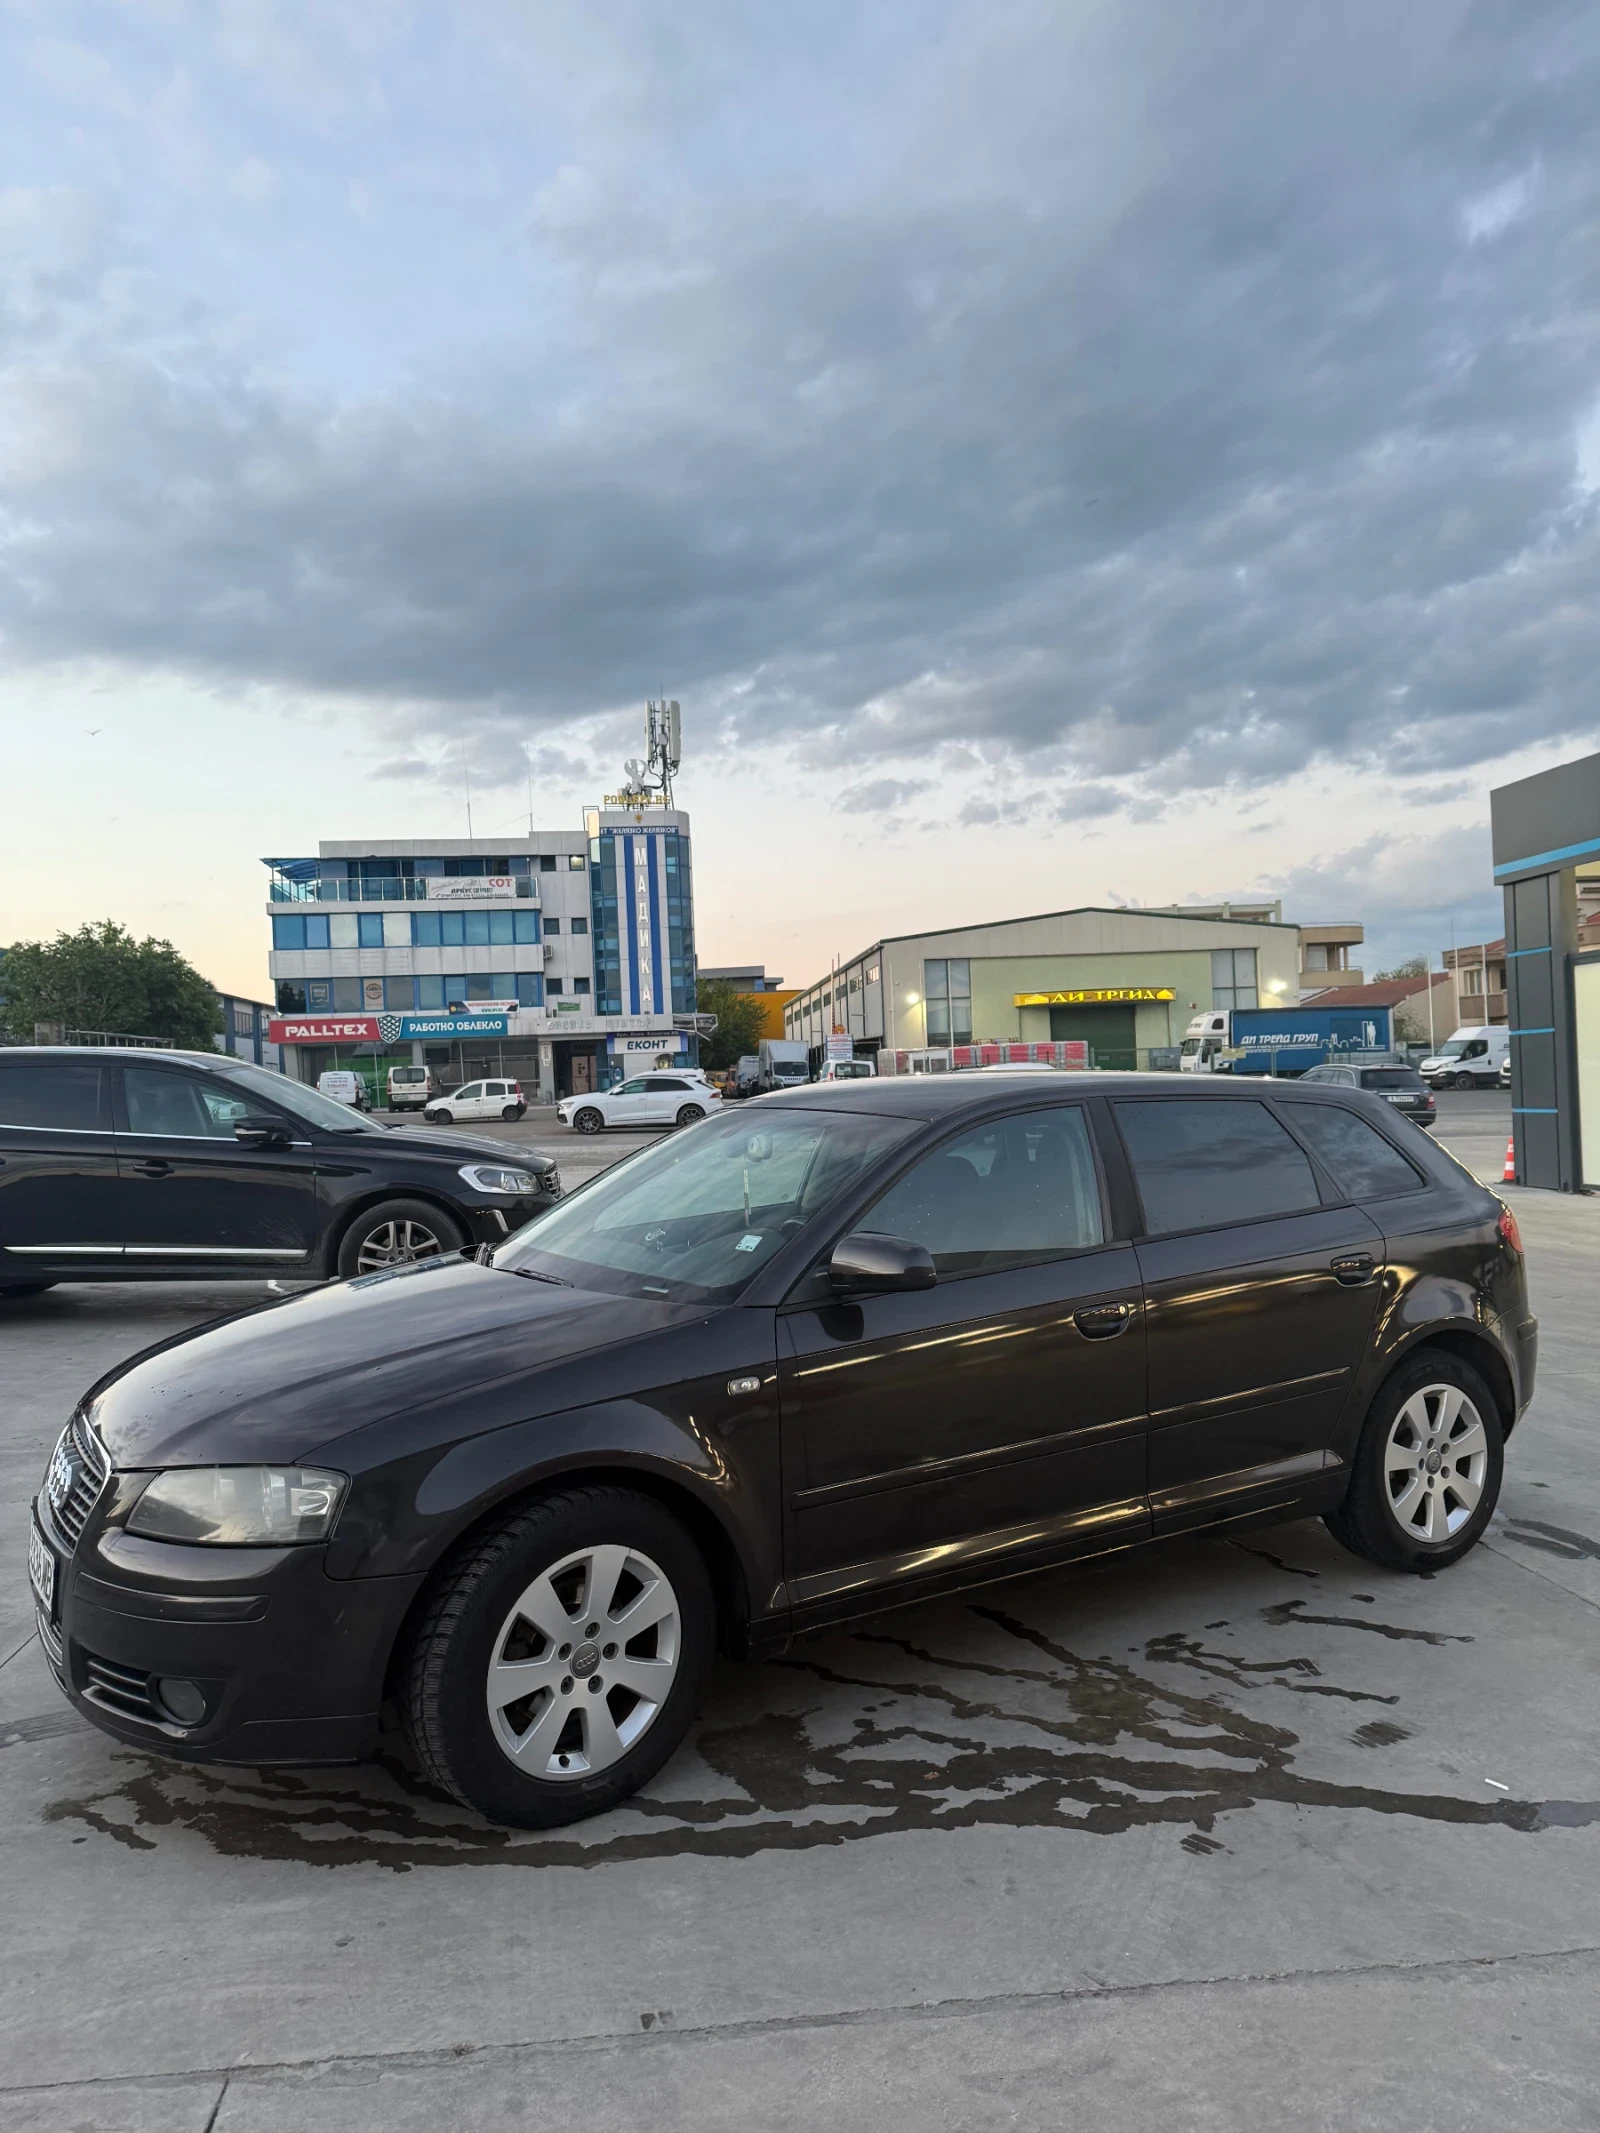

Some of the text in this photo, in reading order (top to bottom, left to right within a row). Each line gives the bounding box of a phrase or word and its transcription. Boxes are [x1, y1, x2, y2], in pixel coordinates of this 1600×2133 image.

[489, 879, 512, 887] СОТ
[635, 847, 651, 1001] МАДИКА
[285, 1024, 368, 1037] PALLTEX
[409, 1021, 502, 1032] РАБОТНО ОБЛЕКЛО
[1241, 1033, 1319, 1045] ДИ ТРЕЙД ГРУП
[627, 1040, 668, 1050] ЕКОНТ
